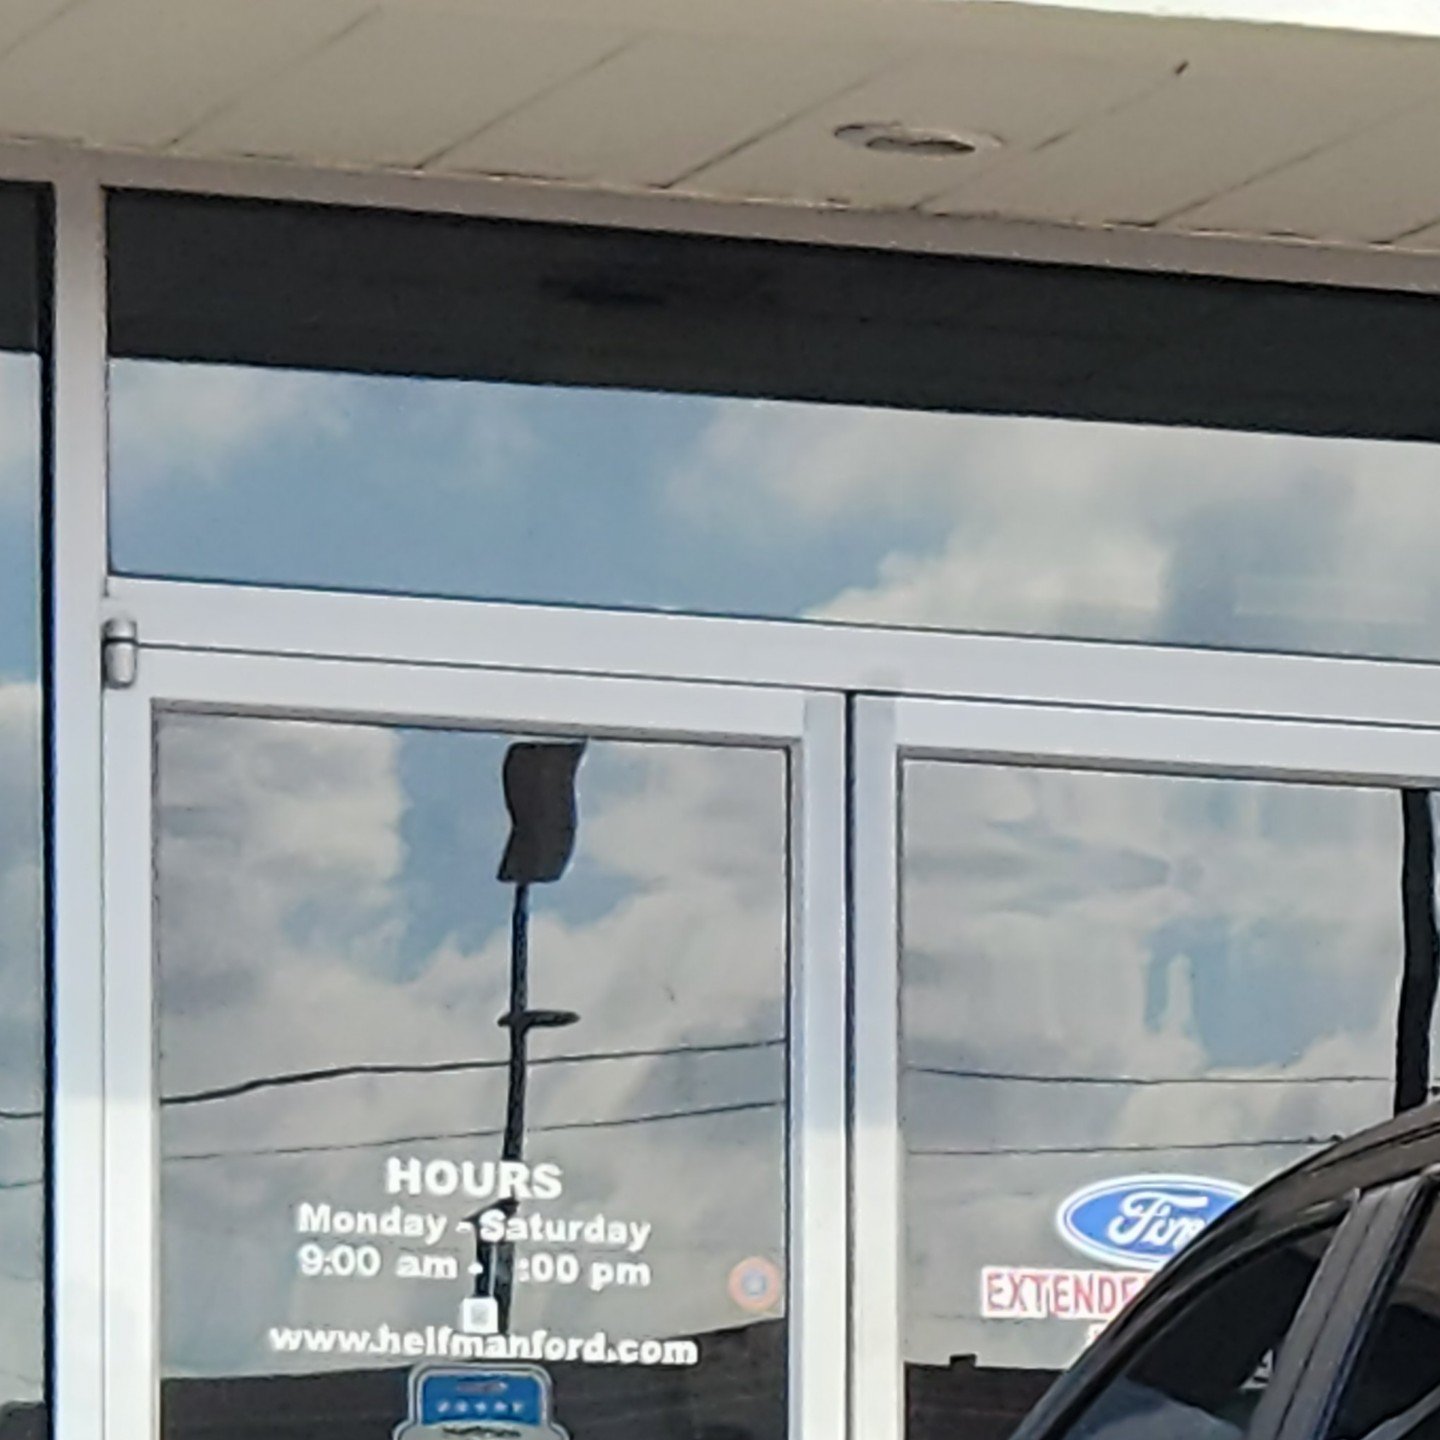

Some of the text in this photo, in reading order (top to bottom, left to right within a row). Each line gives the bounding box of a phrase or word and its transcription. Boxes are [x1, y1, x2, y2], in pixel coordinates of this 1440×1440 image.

[386, 1156, 563, 1199] HOURS
[298, 1203, 448, 1244] Monday
[479, 1209, 652, 1251] Saturday
[1105, 1190, 1208, 1249] For
[299, 1244, 381, 1278] 9:00
[396, 1253, 458, 1280] am
[590, 1260, 652, 1291] pm
[986, 1271, 1150, 1314] EXTENDE
[269, 1324, 699, 1365] www.helfmanford.com
